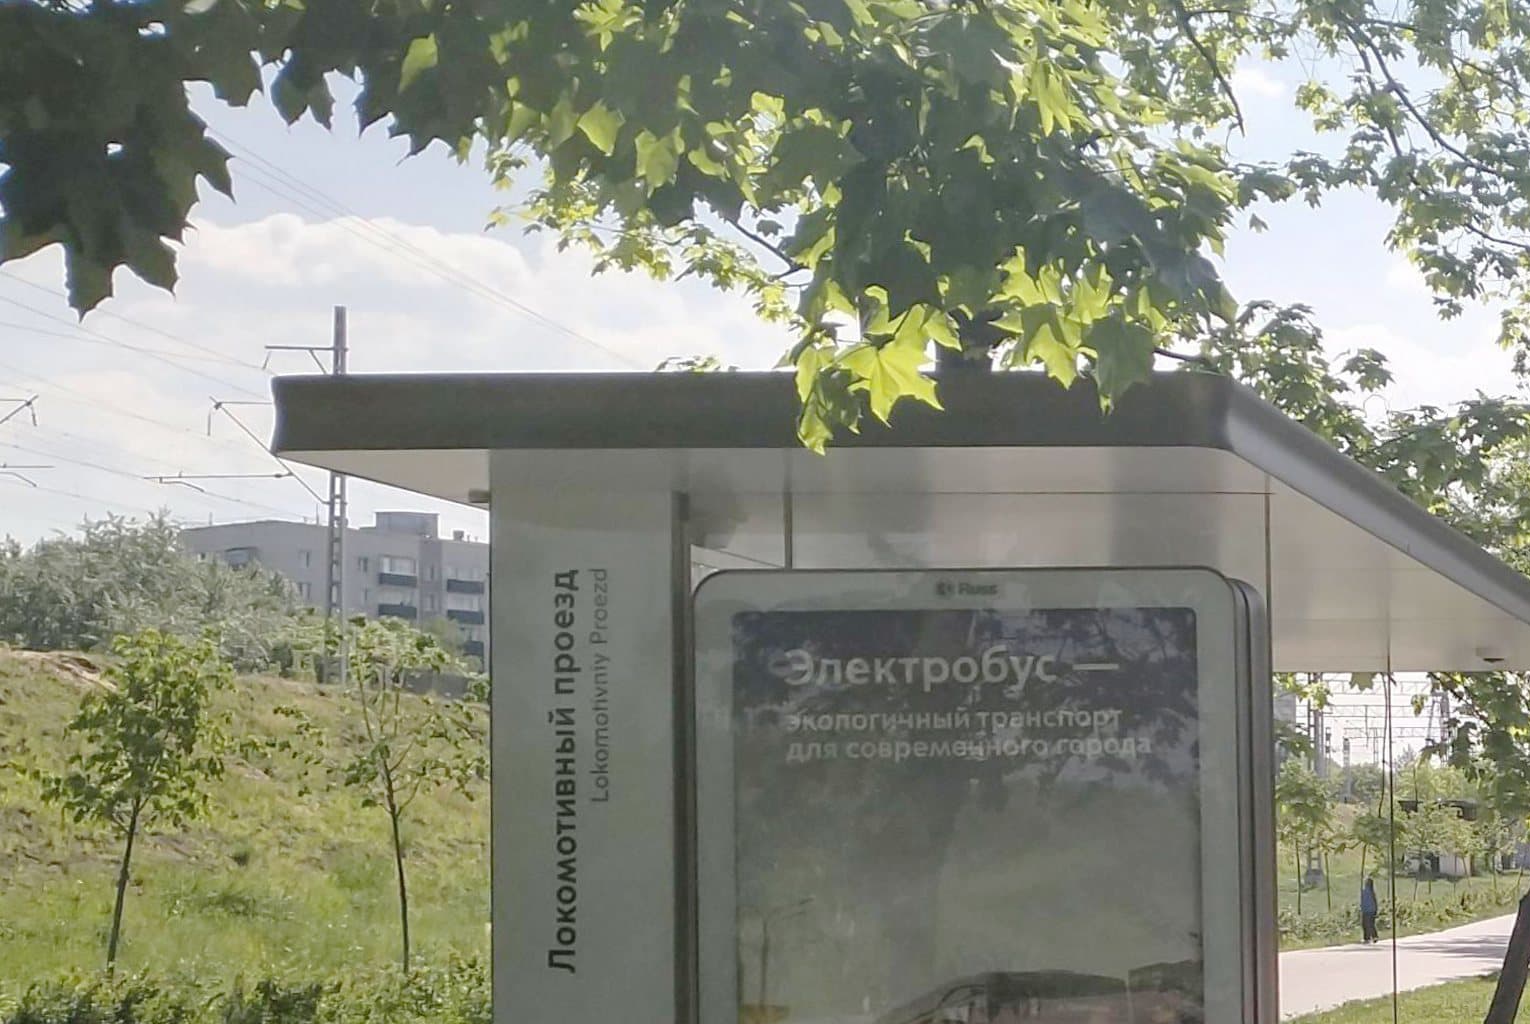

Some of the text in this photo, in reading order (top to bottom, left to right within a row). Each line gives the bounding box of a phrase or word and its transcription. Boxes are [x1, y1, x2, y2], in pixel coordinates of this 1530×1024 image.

[589, 568, 609, 644] Proezd
[785, 646, 1057, 692] Электробус
[785, 706, 1123, 735] экологичный транспорт
[548, 568, 581, 974] Локомотивный проезд
[785, 736, 1152, 764] для современного города
